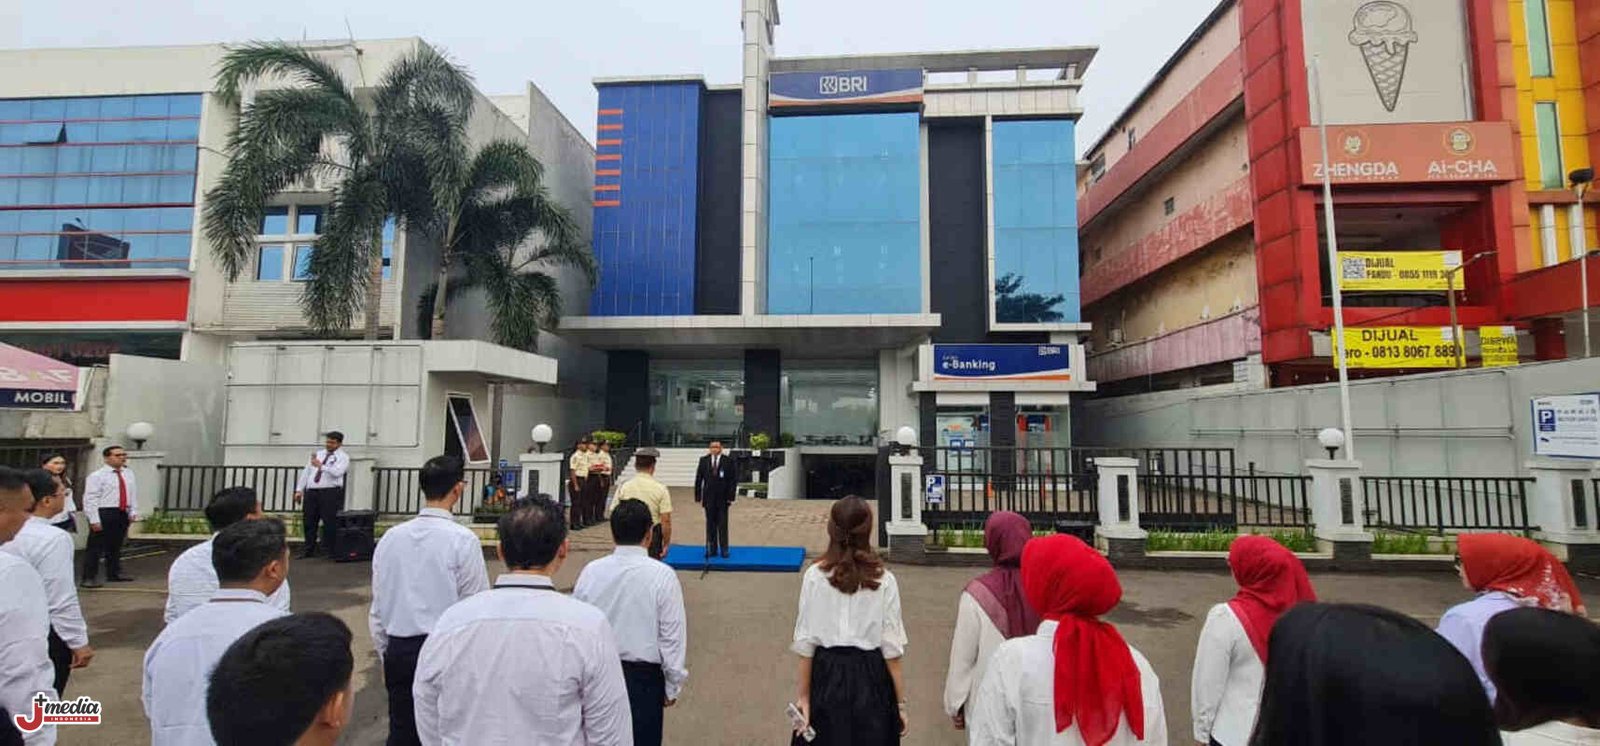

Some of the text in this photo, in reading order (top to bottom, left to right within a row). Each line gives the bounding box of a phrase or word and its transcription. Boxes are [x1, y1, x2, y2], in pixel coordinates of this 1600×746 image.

[839, 76, 867, 92] BRI
[1312, 161, 1399, 177] ZHENGDA
[1361, 329, 1419, 341] DIJUAL
[1334, 346, 1362, 359] ero
[1372, 345, 1400, 358] 0813
[1403, 345, 1430, 358] 8067
[942, 360, 996, 371] e-Banking
[14, 391, 68, 404] MOBIL
[1541, 410, 1552, 423] P
